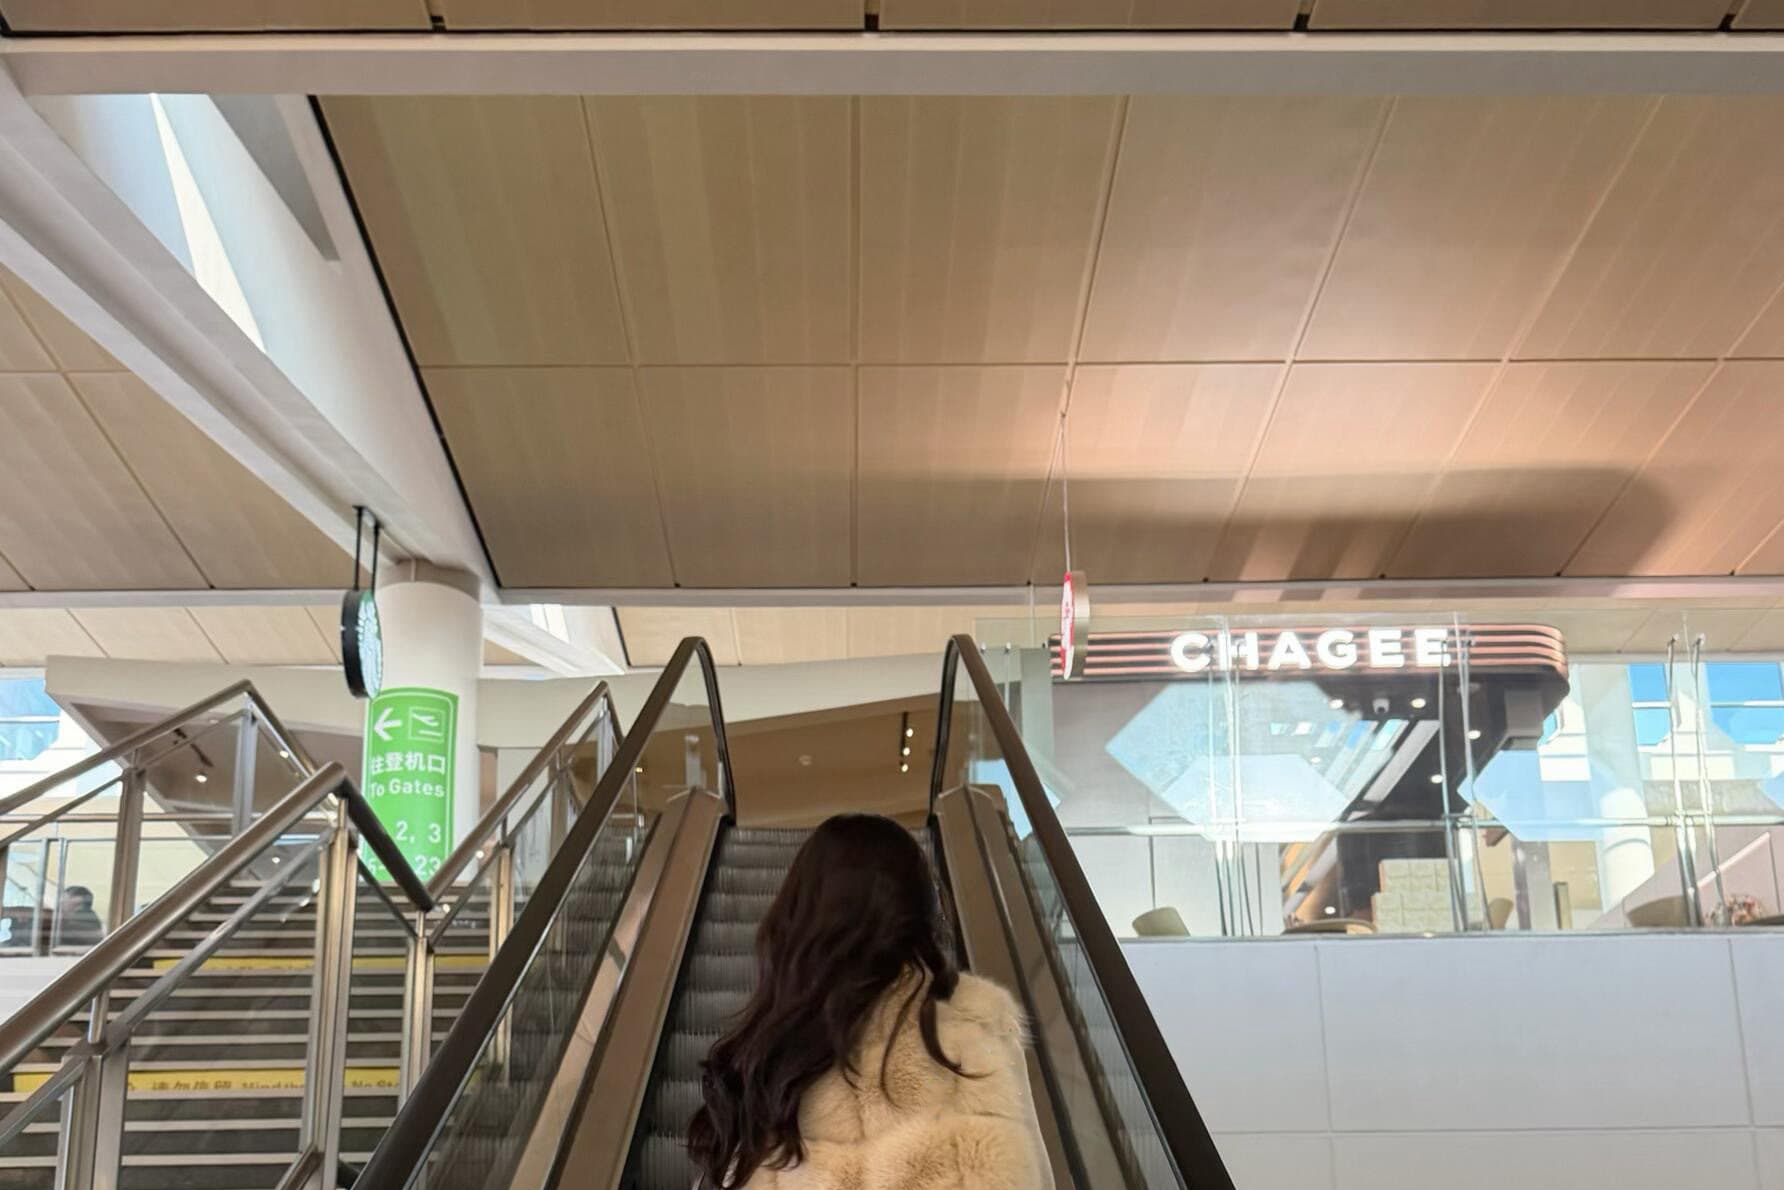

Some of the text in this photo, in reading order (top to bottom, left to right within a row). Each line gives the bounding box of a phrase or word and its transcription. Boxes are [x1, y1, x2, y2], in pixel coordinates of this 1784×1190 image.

[1170, 628, 1451, 672] CHAGEE
[370, 752, 446, 775] 往登机口
[371, 778, 445, 797] To Gates
[427, 822, 442, 844] 3
